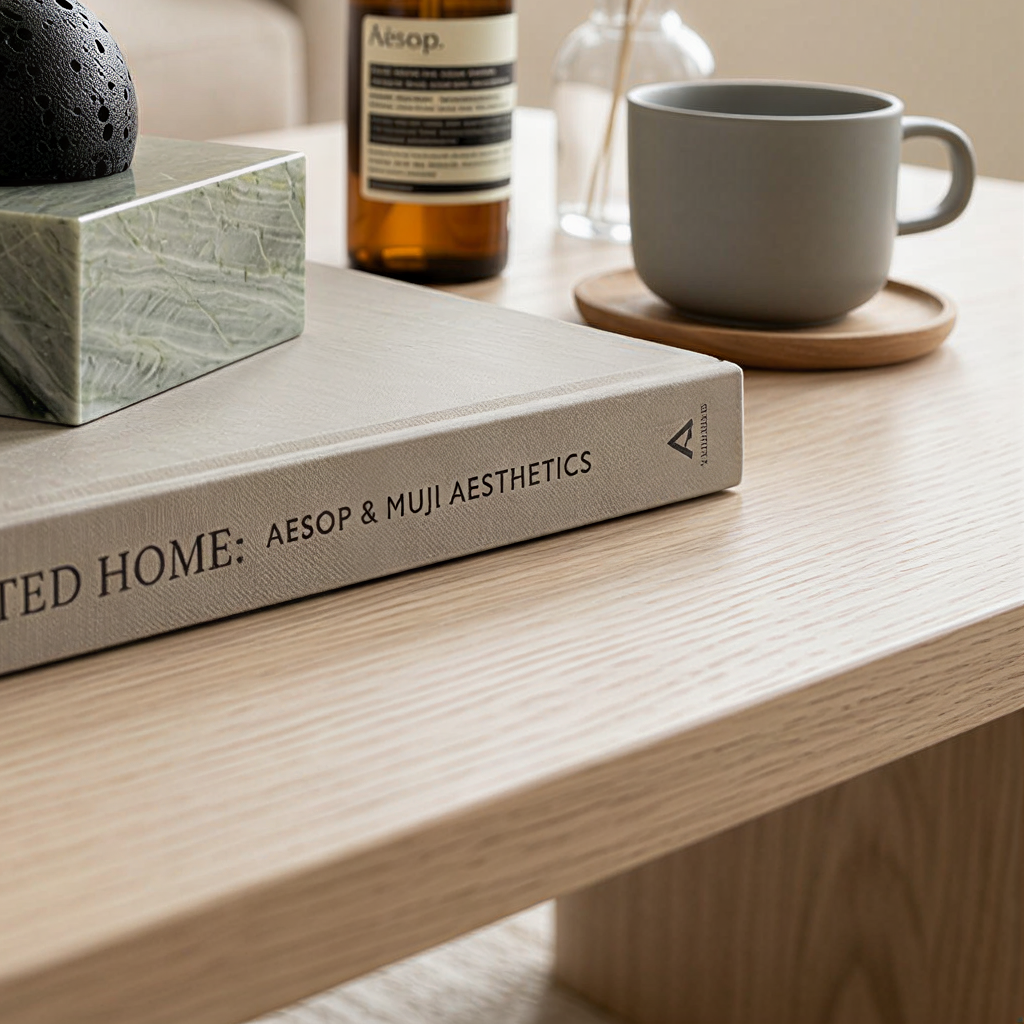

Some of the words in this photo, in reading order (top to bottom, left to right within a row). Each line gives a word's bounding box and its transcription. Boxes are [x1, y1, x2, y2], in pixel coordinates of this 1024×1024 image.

[98, 527, 244, 598] HOME:
[265, 506, 352, 549] AESOP
[360, 500, 379, 525] &
[387, 484, 441, 520] MUJI
[448, 450, 592, 506] AESTHETICS
